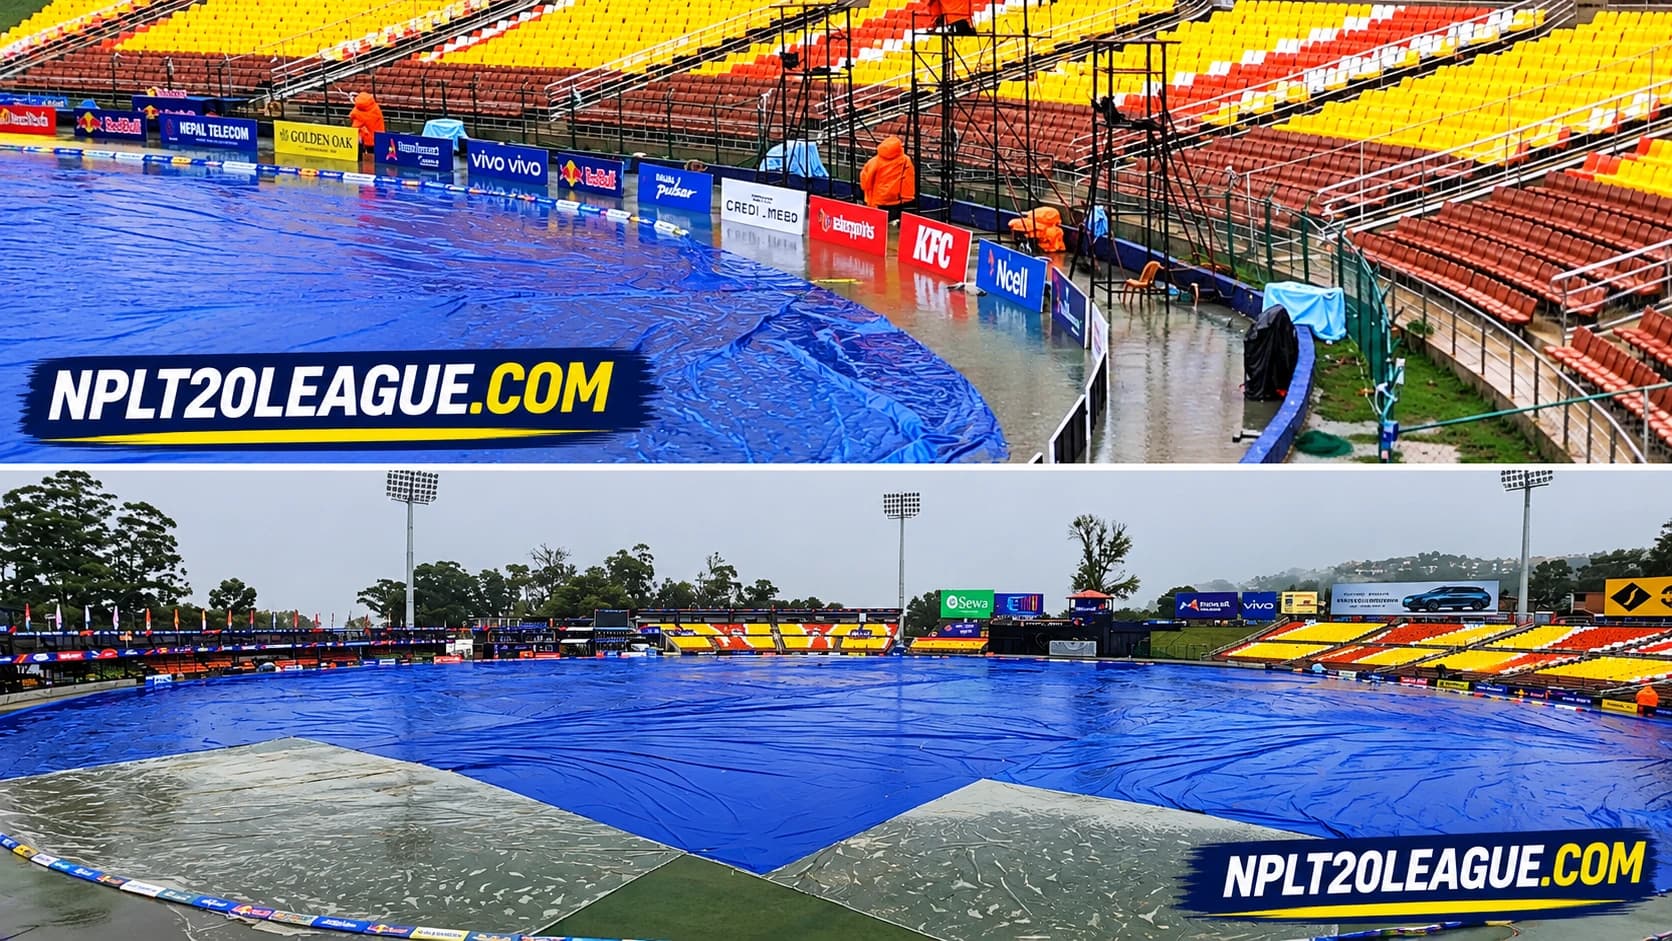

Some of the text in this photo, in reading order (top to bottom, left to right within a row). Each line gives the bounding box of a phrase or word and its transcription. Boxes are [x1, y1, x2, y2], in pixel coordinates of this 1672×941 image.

[180, 121, 250, 141] NEPAL TELECOM
[290, 130, 353, 149] GOLDEN OAK
[471, 149, 542, 176] vivo vivo
[912, 223, 954, 270] KFC
[995, 258, 1029, 299] Ncell
[958, 595, 989, 610] Sewa
[1243, 599, 1274, 610] vivo
